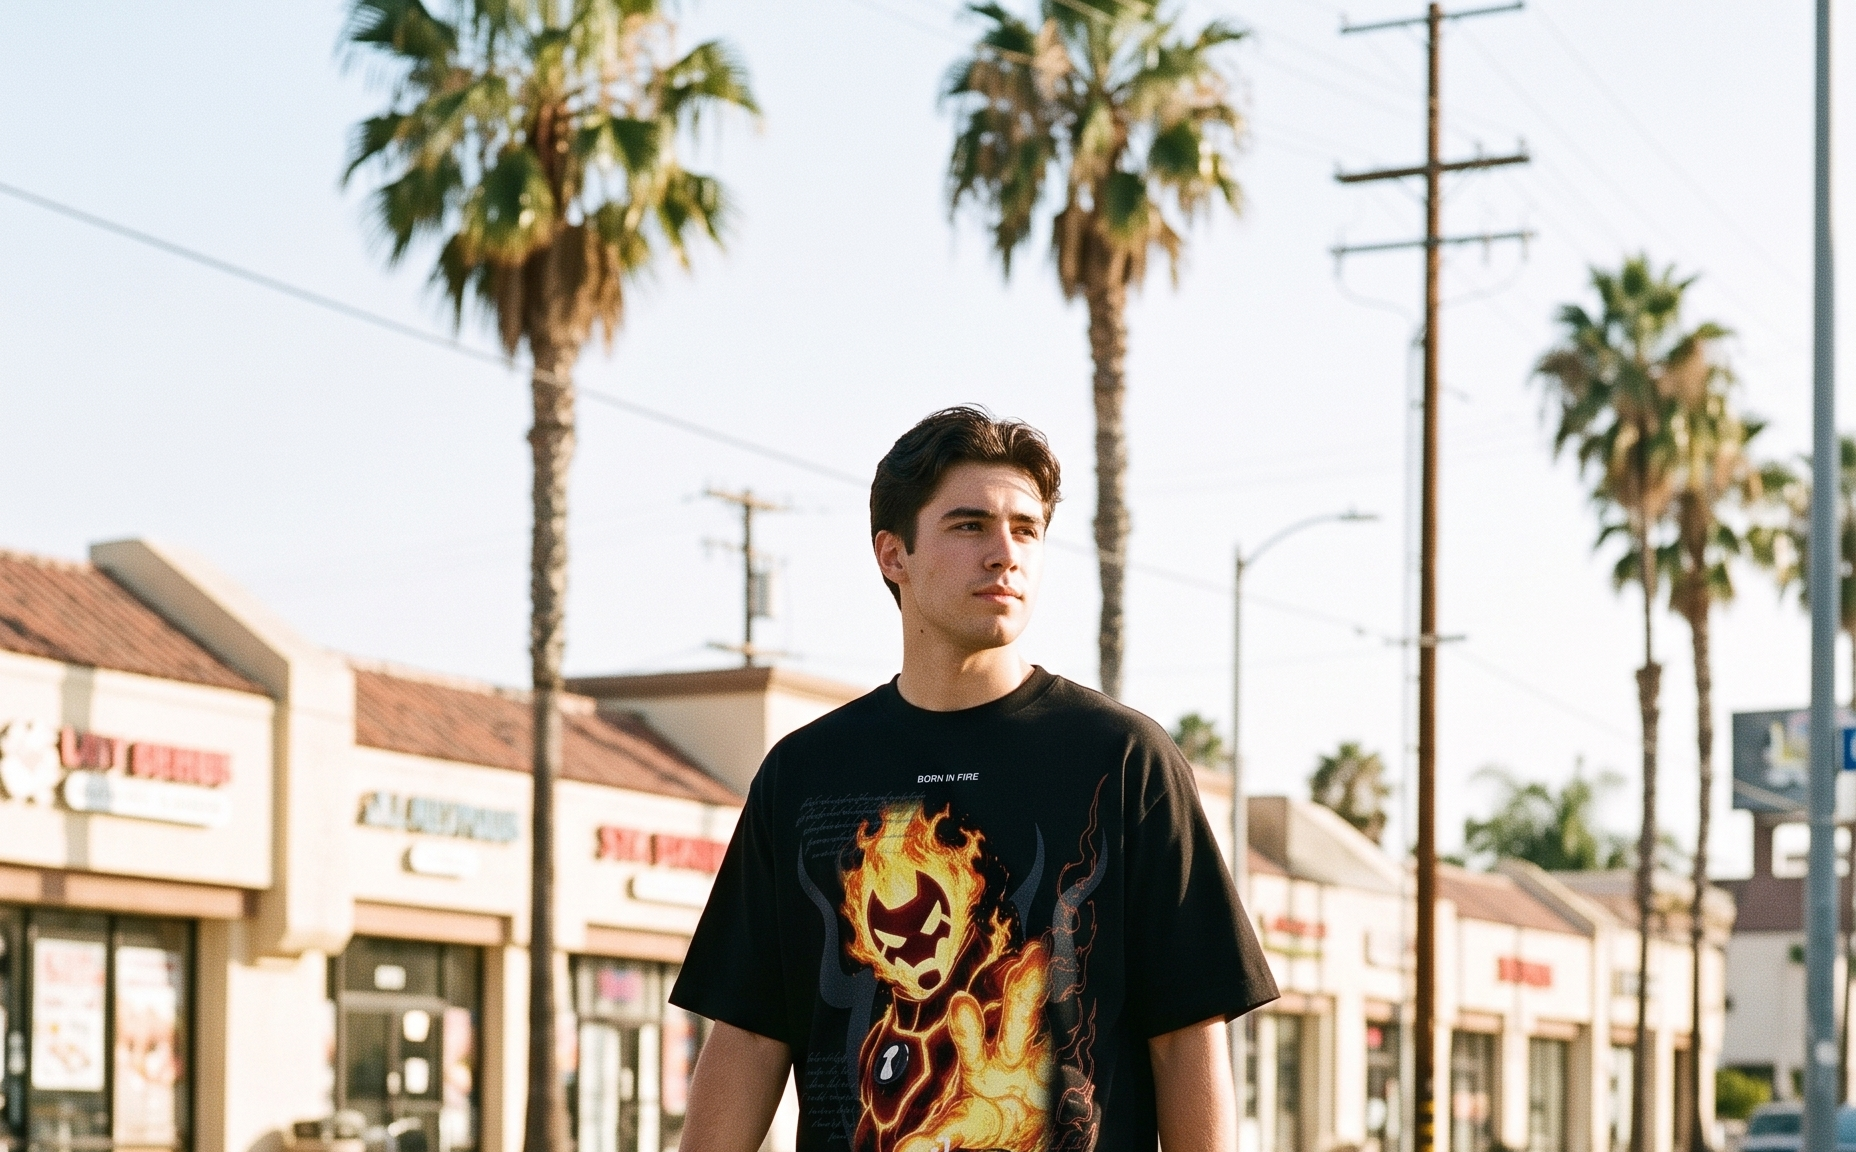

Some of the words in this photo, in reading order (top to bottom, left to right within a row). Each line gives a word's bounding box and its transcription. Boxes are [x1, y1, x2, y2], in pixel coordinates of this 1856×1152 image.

[917, 774, 944, 783] BORN
[945, 773, 955, 782] IN
[956, 772, 979, 781] FIRE
